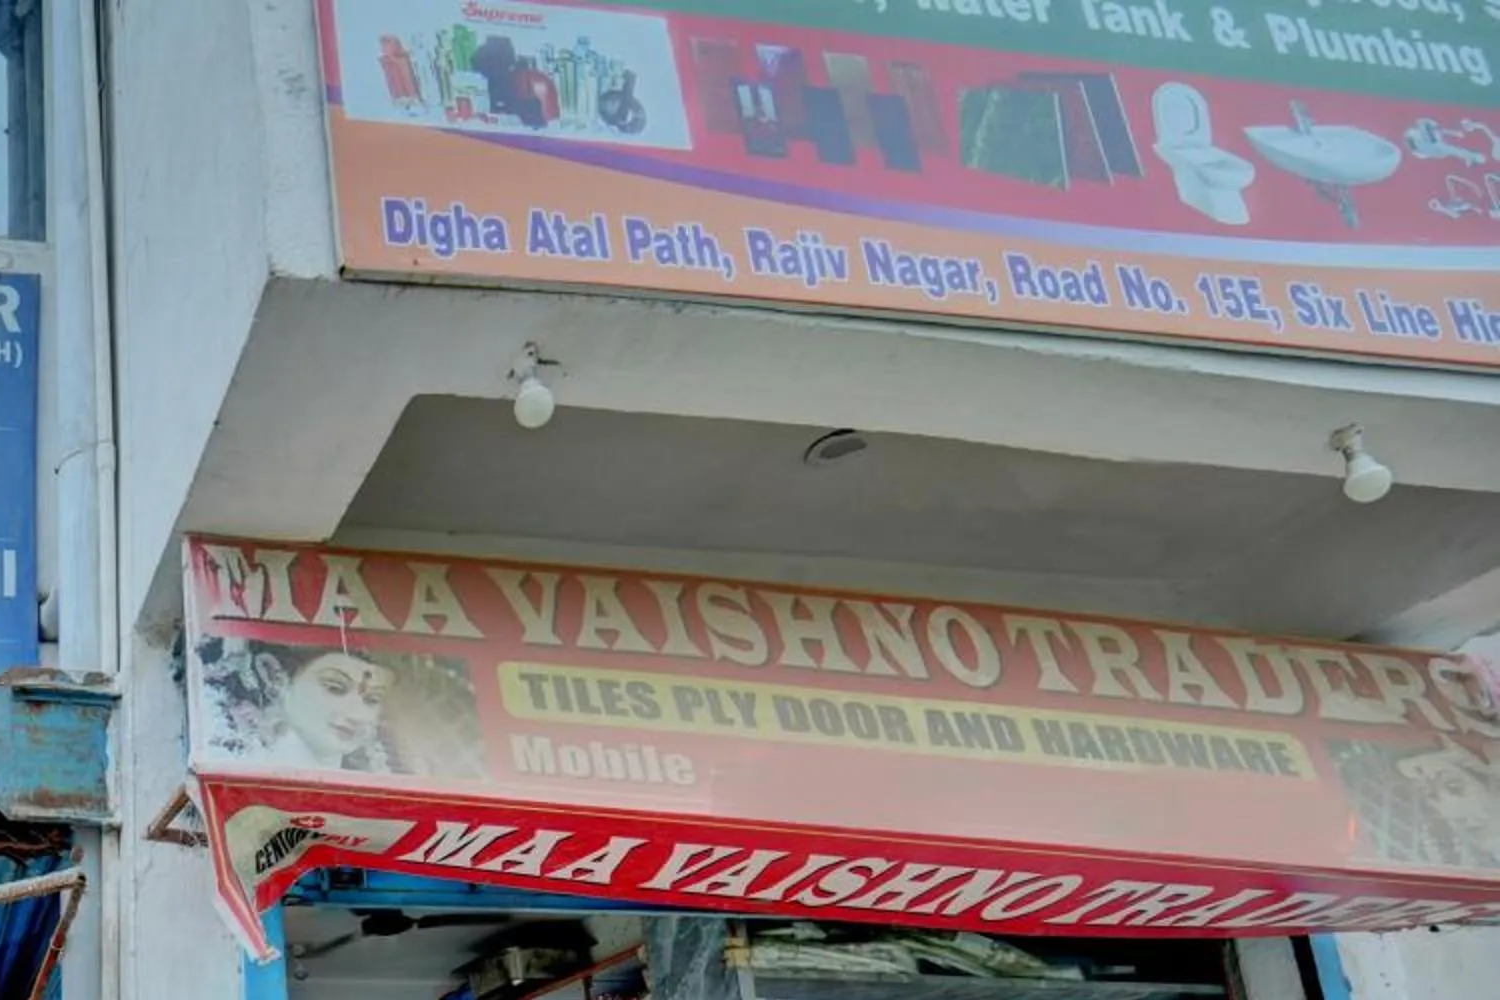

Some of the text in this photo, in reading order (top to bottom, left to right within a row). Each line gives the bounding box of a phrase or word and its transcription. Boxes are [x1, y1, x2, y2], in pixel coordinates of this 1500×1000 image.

[1209, 7, 1252, 49] &
[1264, 12, 1493, 87] Plumbing
[381, 196, 507, 258] Digha
[528, 207, 611, 261] Atal
[624, 216, 736, 279] Path,
[746, 228, 849, 287] Rajiv
[863, 238, 998, 302] Nagar,
[1003, 251, 1106, 306] Road
[1116, 264, 1187, 315] No.
[1198, 274, 1284, 334] 15E,
[1288, 281, 1354, 332] Six
[1355, 288, 1443, 341] Line
[200, 544, 486, 641] MAA
[484, 566, 1002, 688] VAISHNO
[509, 733, 697, 787] Mobile
[518, 670, 1302, 777] TILES PLY DOOR AND HARDWARE
[392, 820, 647, 887] MAA
[637, 841, 1084, 922] VAISHNO
